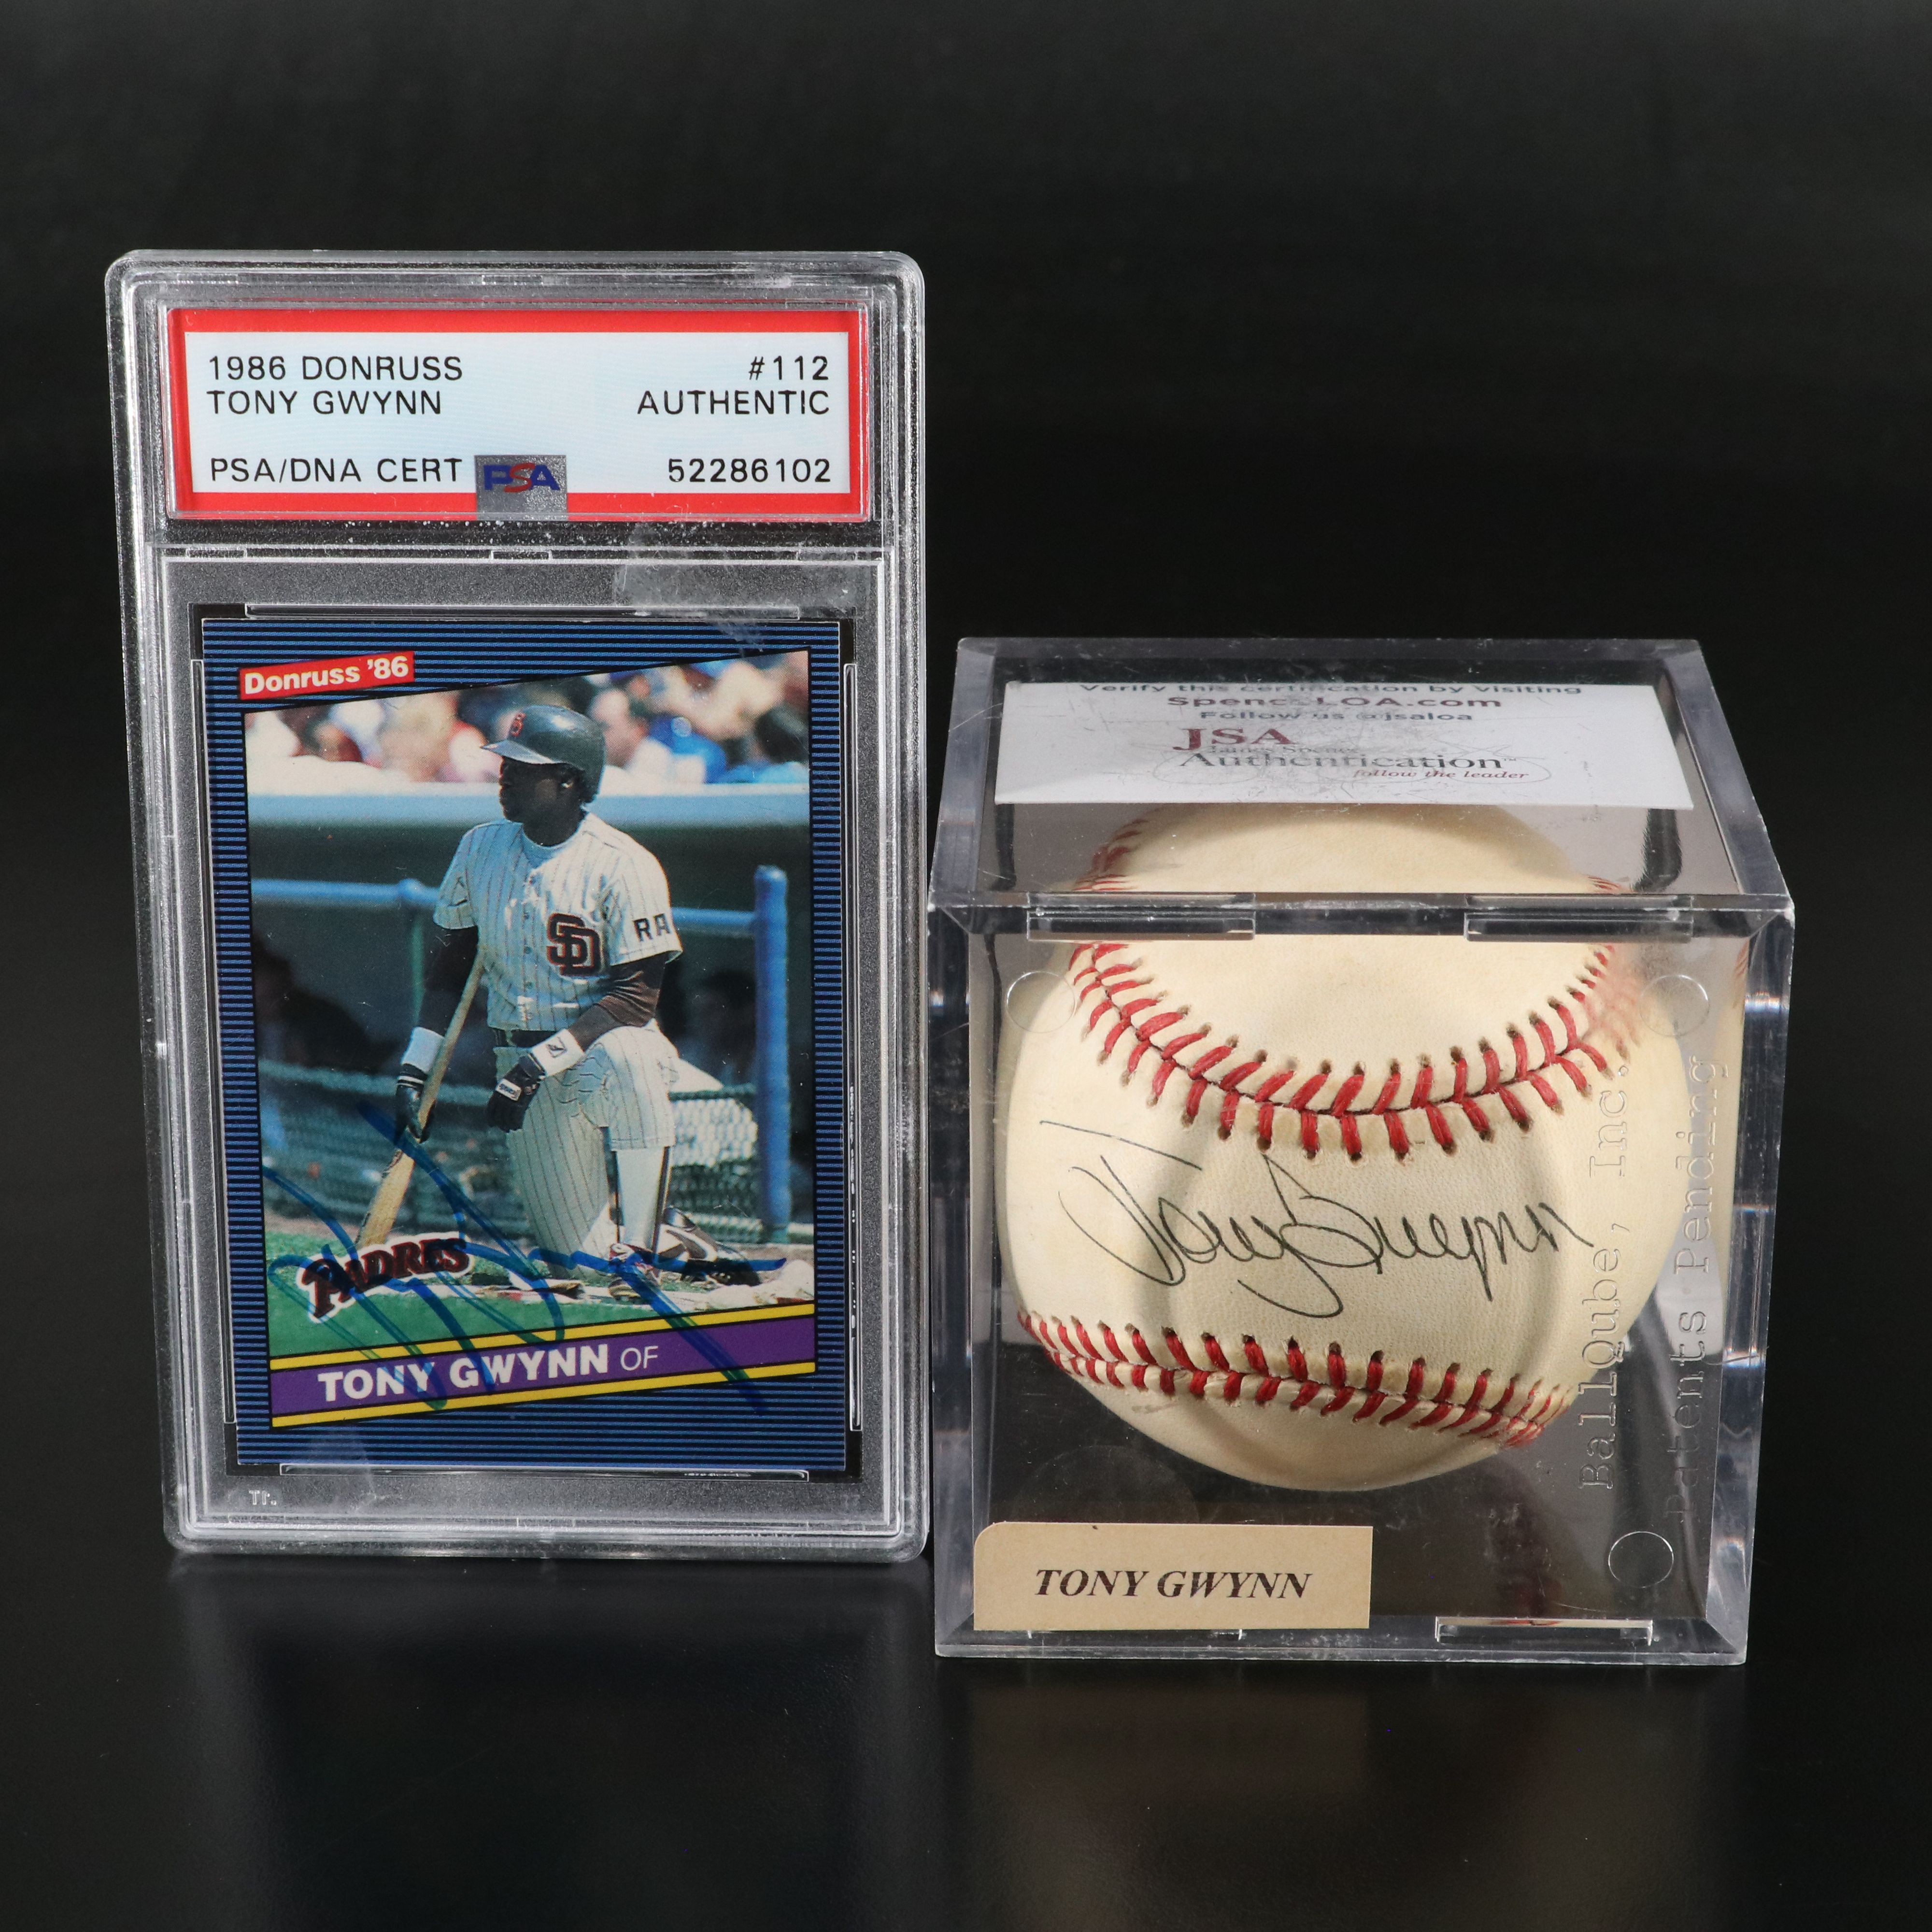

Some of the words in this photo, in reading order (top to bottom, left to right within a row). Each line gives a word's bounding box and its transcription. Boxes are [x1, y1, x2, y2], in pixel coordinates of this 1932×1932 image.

[209, 355, 286, 381] 1986
[302, 355, 463, 381] DONRUSS
[748, 355, 829, 381] #112
[206, 390, 298, 415] TONY
[313, 390, 441, 415] GWYNN
[637, 389, 829, 415] AUTHENTIC
[211, 457, 362, 483] PSA/DNA
[377, 457, 463, 483] CERT
[483, 461, 561, 493] PSA
[668, 458, 831, 483] 52286102
[244, 666, 360, 695] Donruss
[1429, 685, 1463, 693] by
[1474, 685, 1582, 694] visiting
[1172, 728, 1300, 751] JSA
[1352, 769, 1417, 778] follow
[1424, 769, 1457, 778] the
[1463, 770, 1529, 779] leader
[633, 913, 672, 942] RA
[546, 912, 604, 977] SD
[1589, 1065, 1629, 1178] Inc.
[1673, 1054, 1729, 1275] Pending
[317, 1360, 435, 1402] TONY
[449, 1343, 609, 1389] GWYNN
[620, 1345, 659, 1371] OF
[1664, 1310, 1707, 1523] Patents
[1035, 1569, 1150, 1597] TONY
[1156, 1570, 1313, 1599] GWYNN
